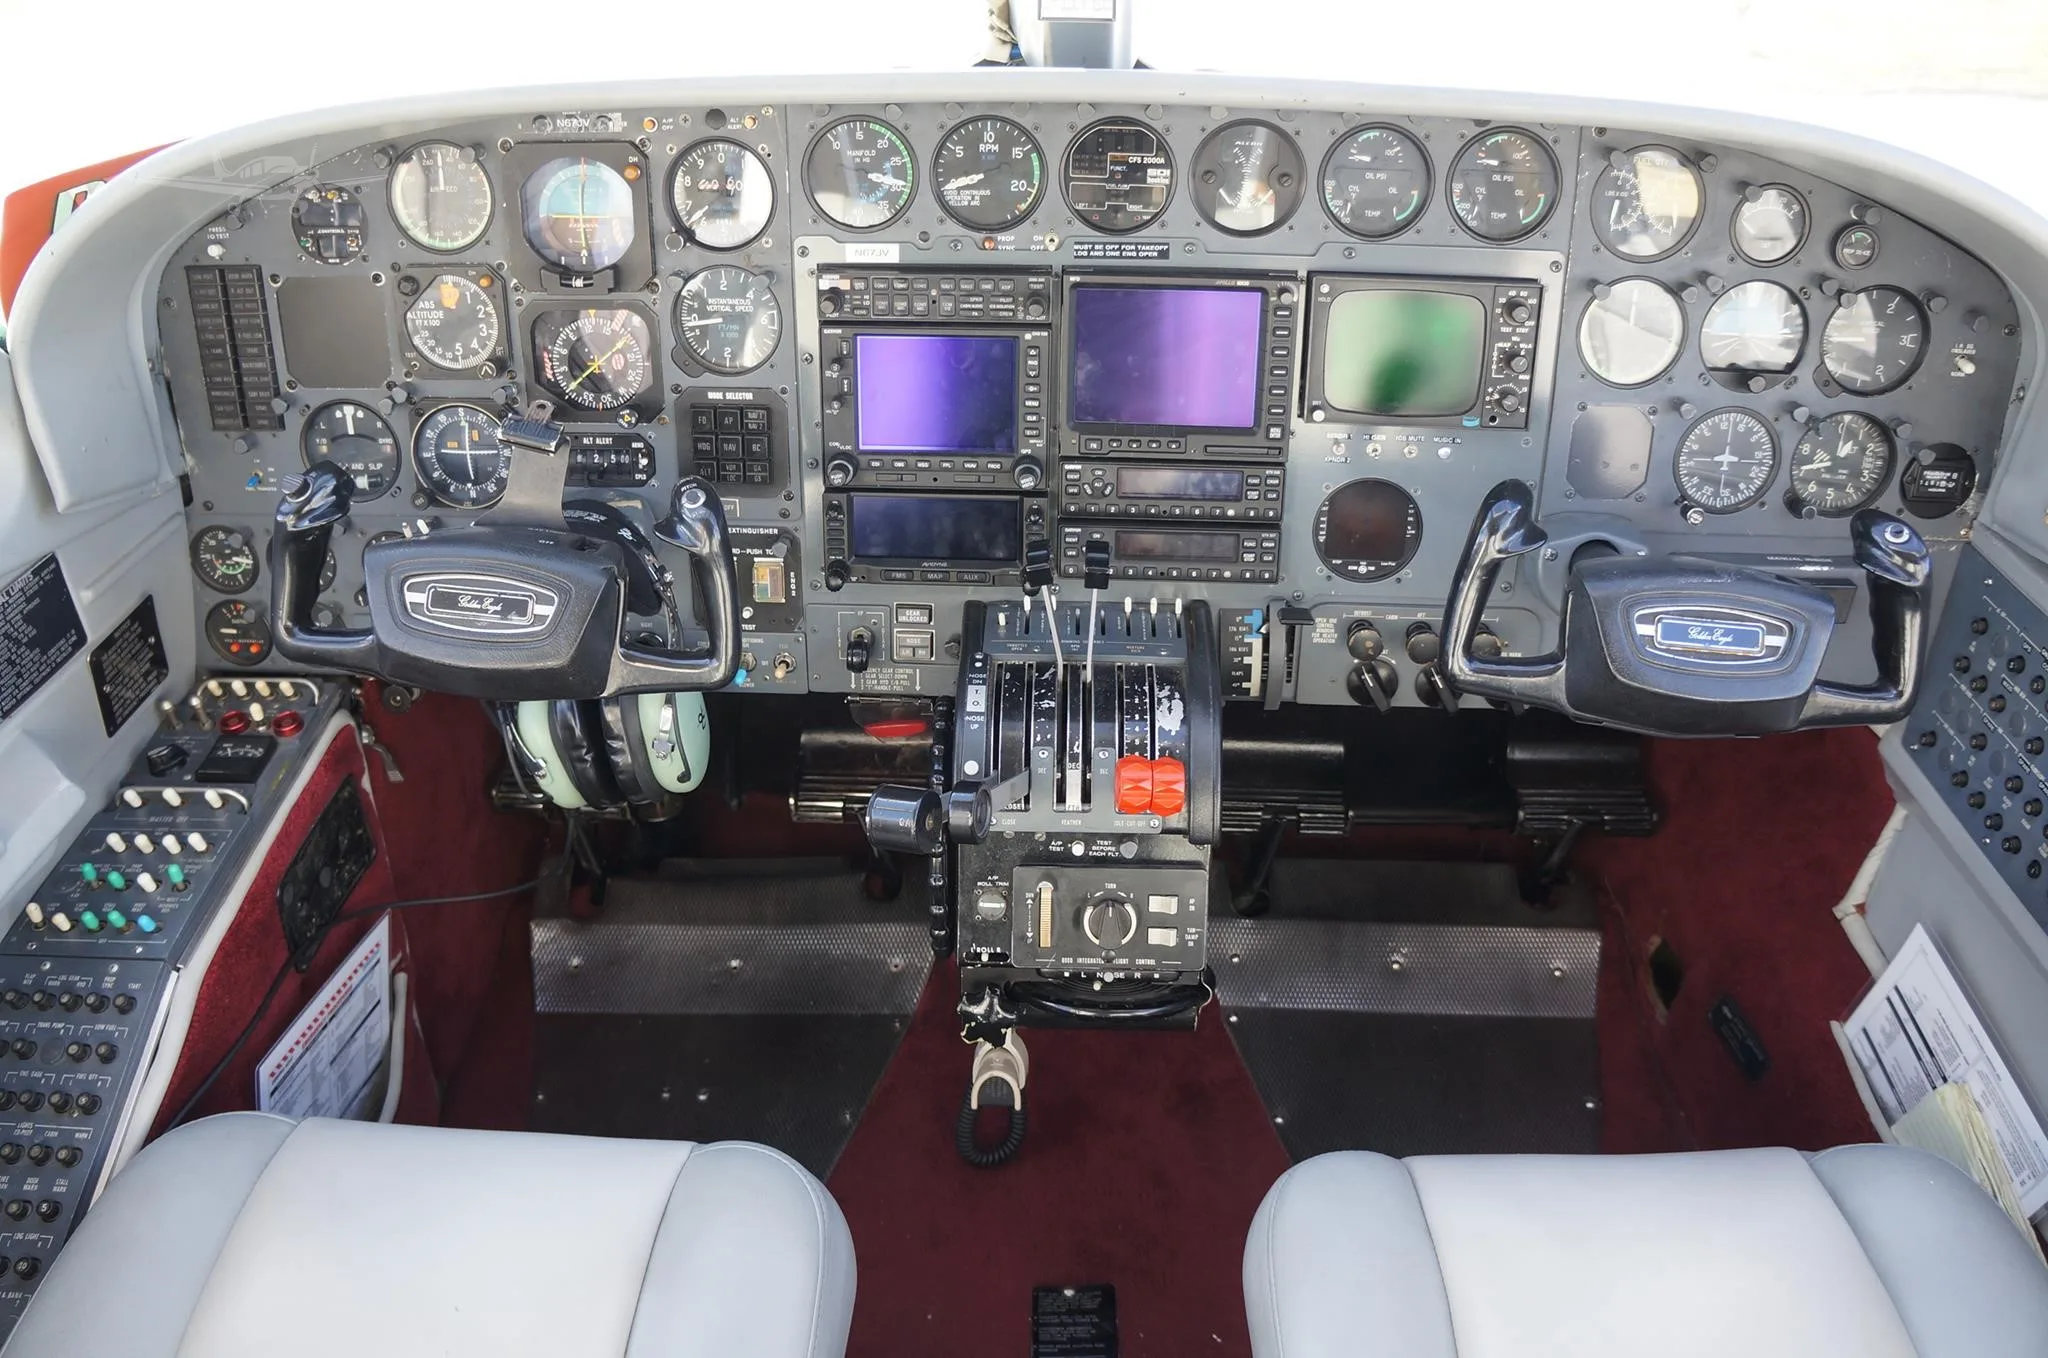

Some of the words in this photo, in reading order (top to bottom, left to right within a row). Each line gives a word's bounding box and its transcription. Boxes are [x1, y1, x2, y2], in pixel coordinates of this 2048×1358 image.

[856, 131, 864, 140] 15
[984, 132, 995, 143] 10
[832, 140, 841, 150] 10
[876, 139, 889, 148] 20
[978, 144, 999, 152] RPM
[955, 147, 964, 157] 5
[1012, 148, 1023, 158] 15
[1512, 152, 1523, 160] 100
[718, 152, 725, 163] 0
[890, 157, 902, 166] 25
[1128, 156, 1142, 164] CFS
[1143, 156, 1165, 164] 2000A
[697, 159, 704, 170] 9
[684, 176, 692, 187] 8
[1376, 173, 1387, 181] PSI
[1492, 174, 1502, 182] OIL
[890, 183, 901, 192] 30
[1010, 181, 1027, 192] 20
[1348, 185, 1360, 193] CYL
[877, 201, 889, 210] 35
[1364, 210, 1381, 218] TEMP
[1490, 212, 1507, 220] TEMP
[720, 280, 728, 290] 2
[465, 291, 471, 304] 1
[708, 298, 751, 306] INSTANTANEOUS
[418, 300, 436, 309] ABS
[730, 305, 754, 313] SPEED
[406, 310, 444, 319] ALTITUDE
[476, 305, 486, 318] 2
[760, 315, 768, 326] 6
[420, 330, 430, 338] 25
[479, 324, 488, 336] 3
[470, 337, 479, 349] 4
[454, 342, 463, 356] 5
[723, 347, 731, 358] 2
[707, 392, 724, 400] MODE
[725, 392, 754, 400] SELECTOR
[698, 416, 706, 424] FD
[724, 416, 733, 424] AP
[582, 436, 594, 445] ALT
[596, 436, 613, 445] ALERT
[698, 442, 711, 450] HDG
[723, 443, 736, 452] NAV
[752, 444, 761, 452] BC
[1866, 443, 1874, 455] 2
[351, 462, 364, 470] AND
[368, 462, 383, 470] SLIP
[1860, 470, 1870, 482] 3
[680, 483, 698, 492] PITCH
[1808, 481, 1817, 492] 6
[1846, 483, 1854, 494] 4
[1826, 488, 1835, 499] 5
[728, 527, 778, 535] EXTINGUISHER
[457, 594, 481, 608] Golden
[481, 596, 502, 614] Eagle
[1688, 625, 1712, 642] Golden
[1712, 627, 1735, 646] Eagle
[1068, 762, 1080, 770] DEC
[1002, 818, 1016, 826] CLOSE
[1061, 818, 1082, 826] FEATHER
